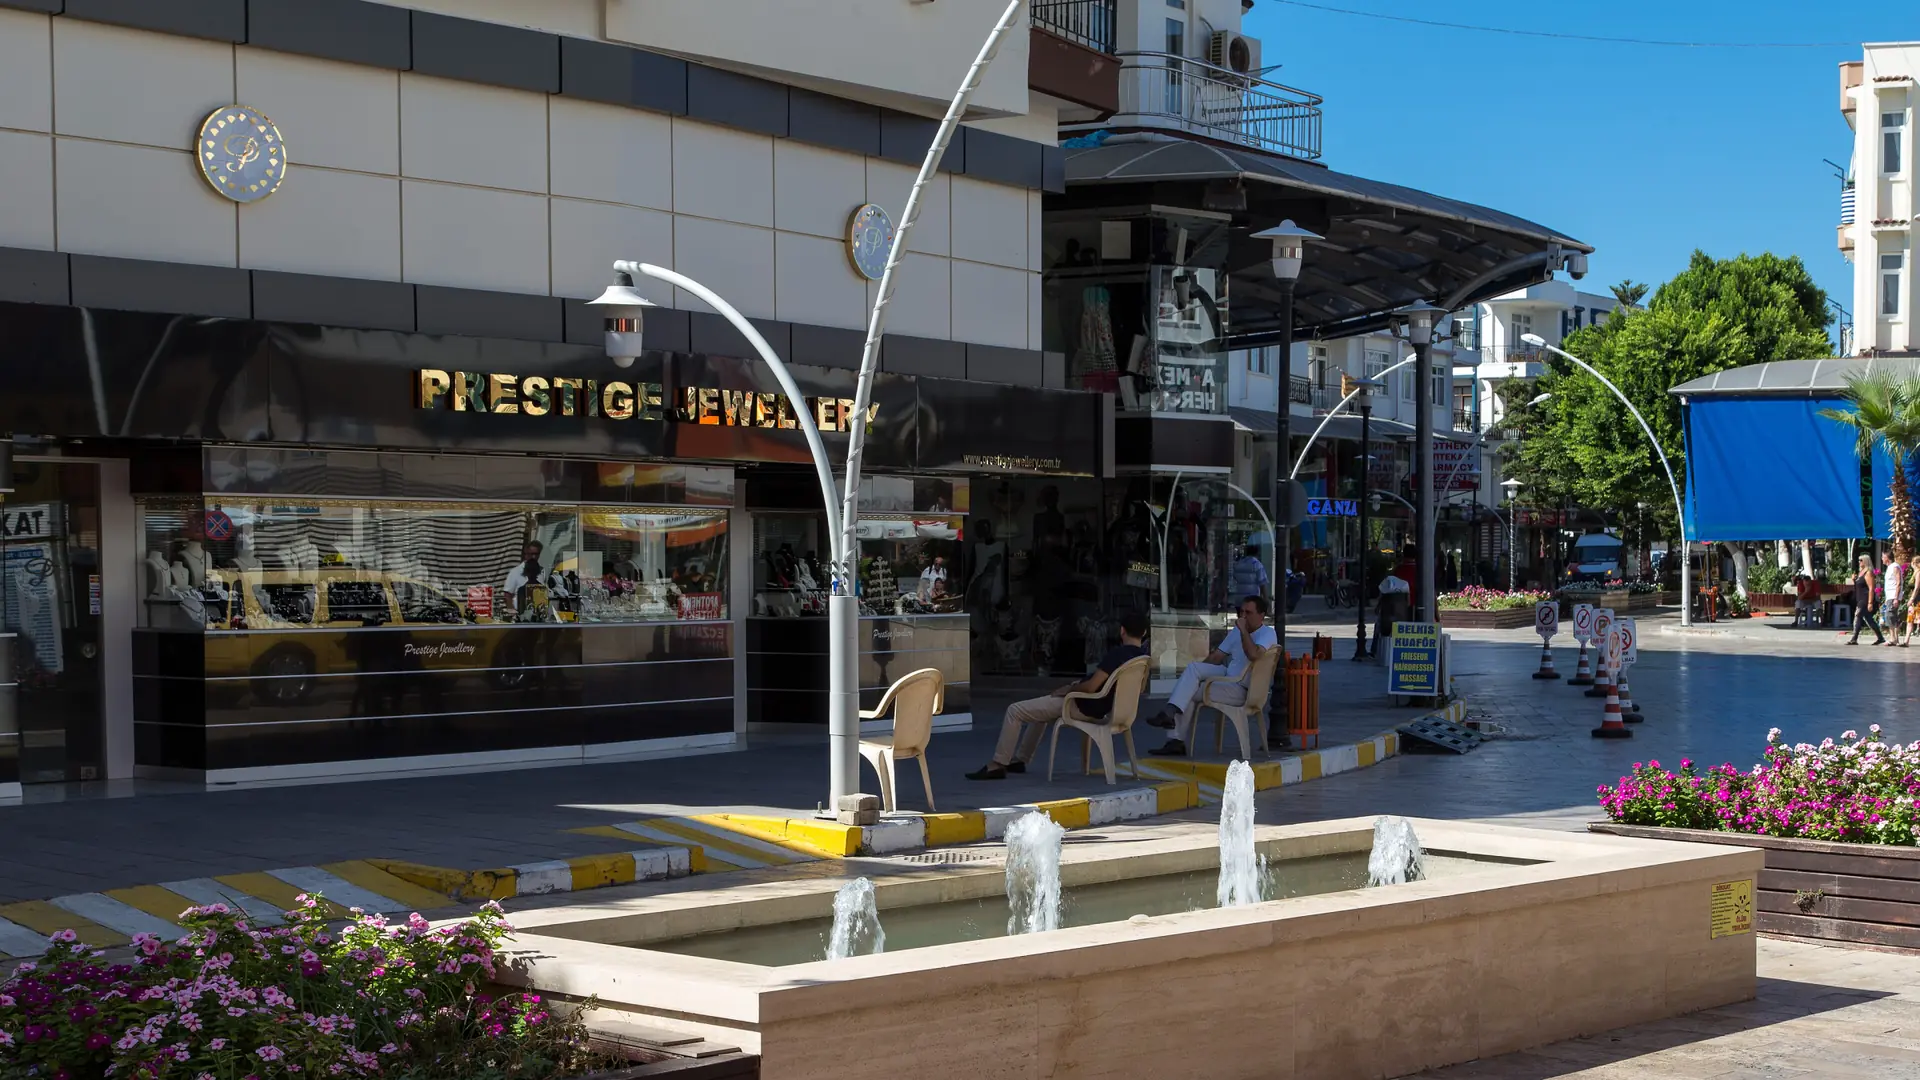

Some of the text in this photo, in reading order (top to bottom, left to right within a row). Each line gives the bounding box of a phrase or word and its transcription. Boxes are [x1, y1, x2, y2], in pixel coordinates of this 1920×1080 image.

[416, 368, 880, 435] PRESTIGE JEWELERY
[963, 453, 1062, 471] www.prestigejewellery.com.tr
[1397, 624, 1435, 635] BELKIS
[404, 642, 476, 658] Prestige Jewellery
[1394, 637, 1437, 648] KUAFÖR
